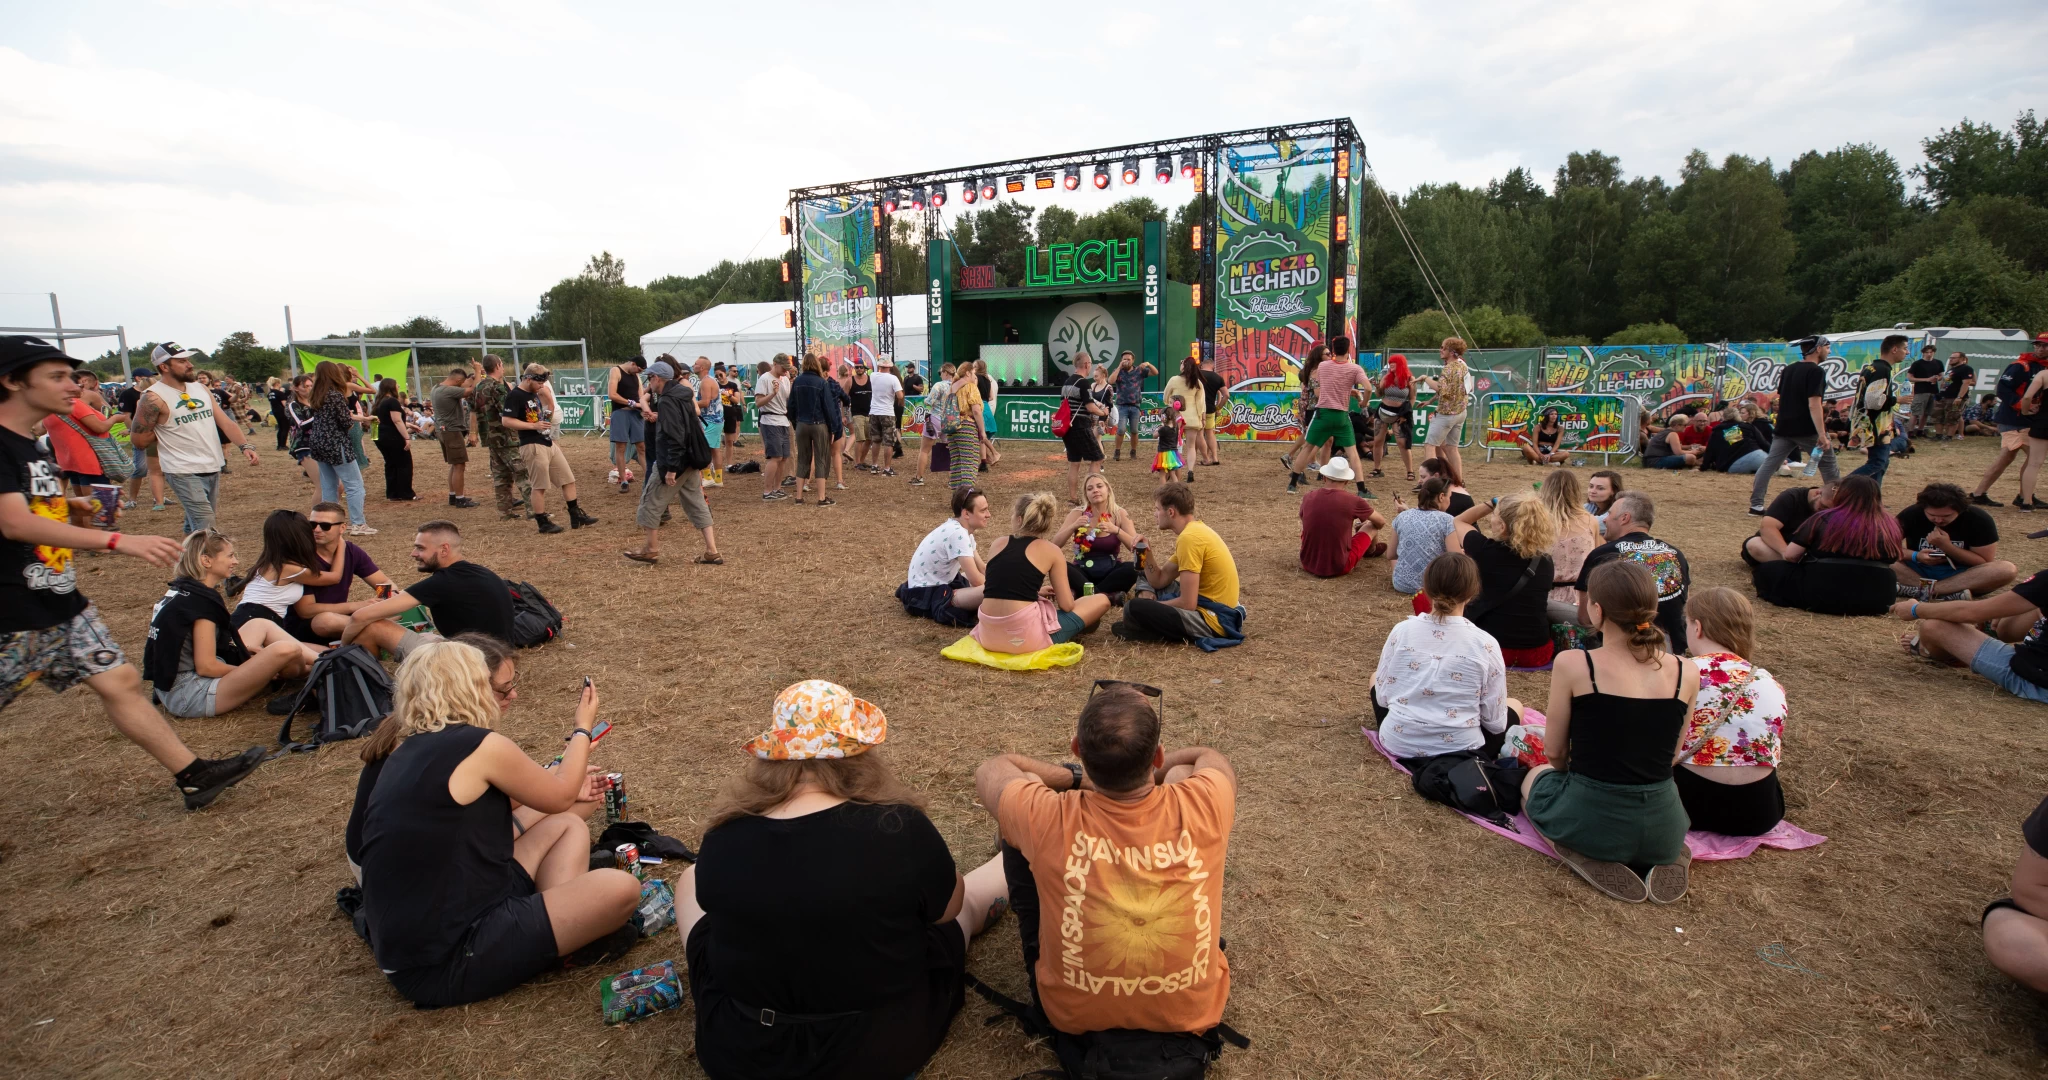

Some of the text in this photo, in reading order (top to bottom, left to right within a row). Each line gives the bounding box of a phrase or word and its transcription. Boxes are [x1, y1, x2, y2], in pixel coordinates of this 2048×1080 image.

[1025, 237, 1138, 287] LECH
[960, 265, 995, 289] SCENA
[1230, 267, 1320, 295] LECHEND
[814, 296, 872, 318] LECHEND
[932, 288, 942, 324] LECH
[1146, 274, 1158, 315] LECH
[1598, 377, 1665, 393] LECHEND
[562, 407, 580, 418] ECH
[1011, 409, 1050, 424] LECH
[1140, 415, 1162, 424] CHEN
[1011, 424, 1050, 434] MUSIC
[1072, 830, 1120, 865] STAY
[1124, 845, 1153, 872] IN
[1153, 829, 1210, 881] SLOW
[1061, 939, 1084, 969] IN
